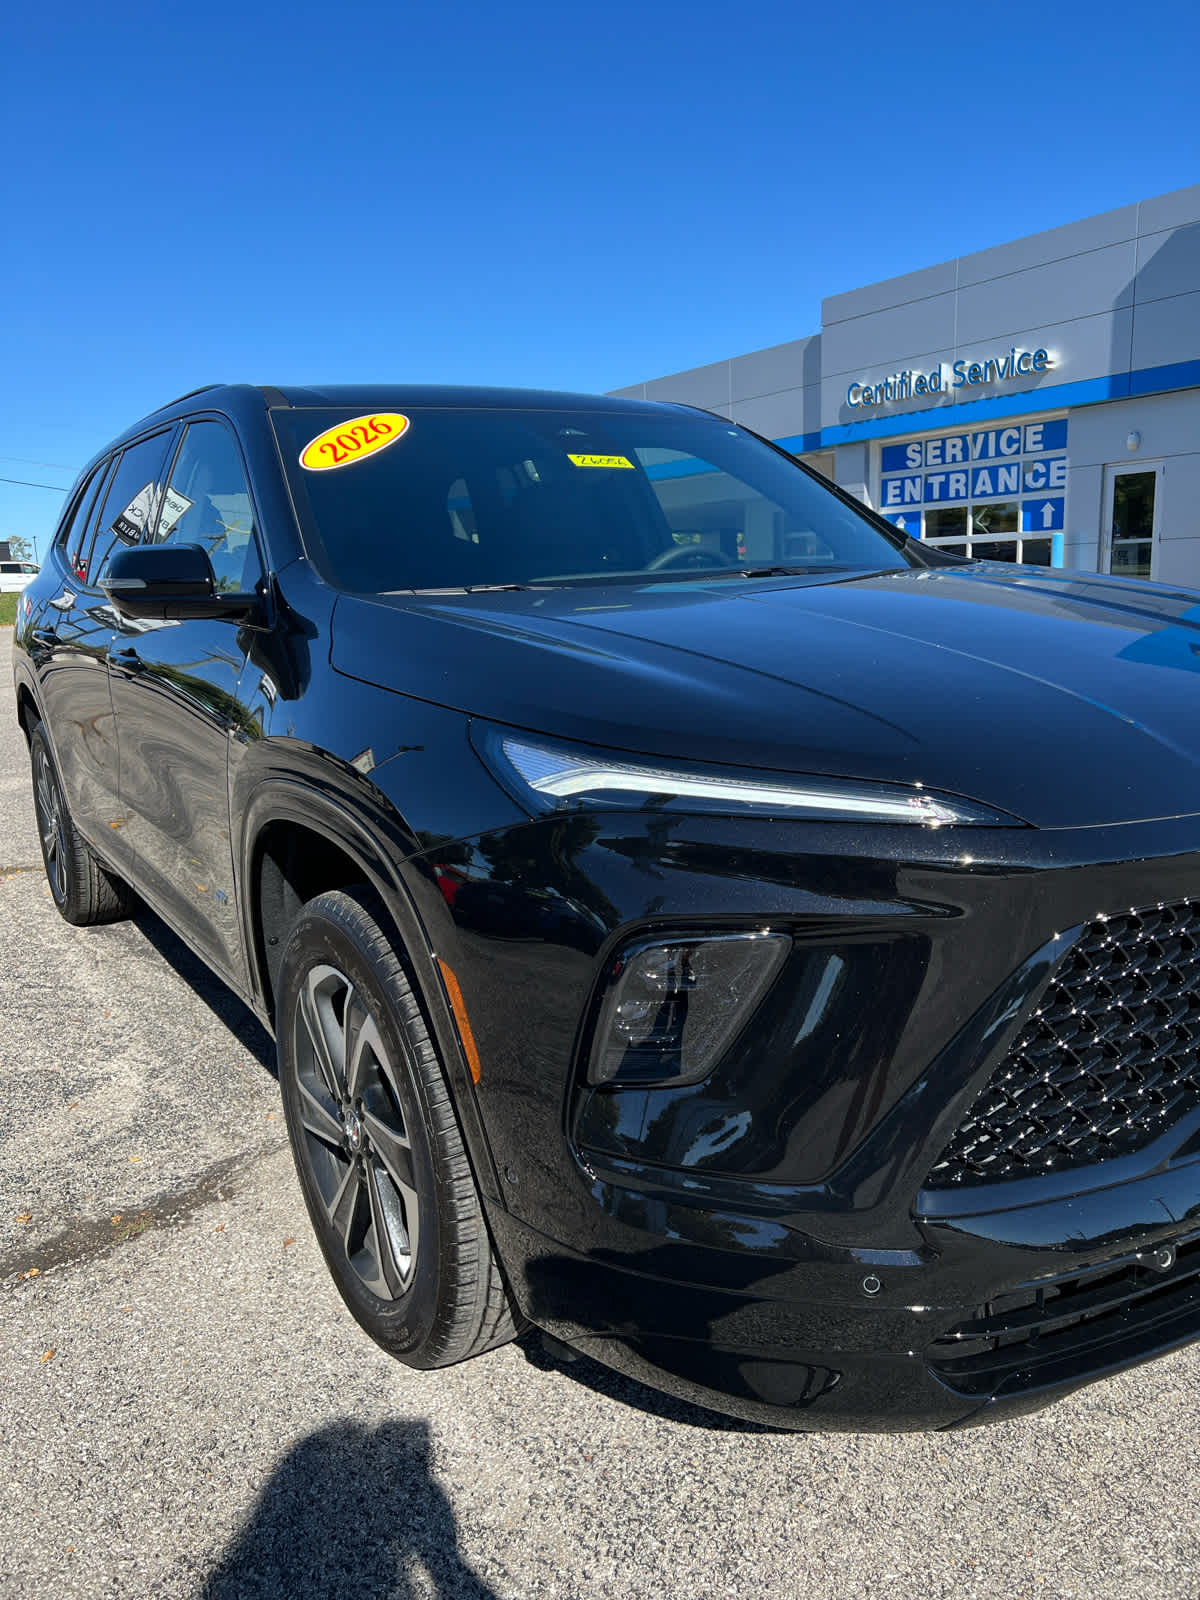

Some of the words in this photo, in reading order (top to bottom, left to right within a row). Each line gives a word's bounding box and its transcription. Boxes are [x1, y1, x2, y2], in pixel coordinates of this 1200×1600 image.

[847, 363, 942, 407] Certified
[952, 348, 1049, 388] Service
[319, 417, 392, 463] 2026
[906, 424, 1044, 469] SERVICE
[887, 459, 1066, 504] ENTRANCE
